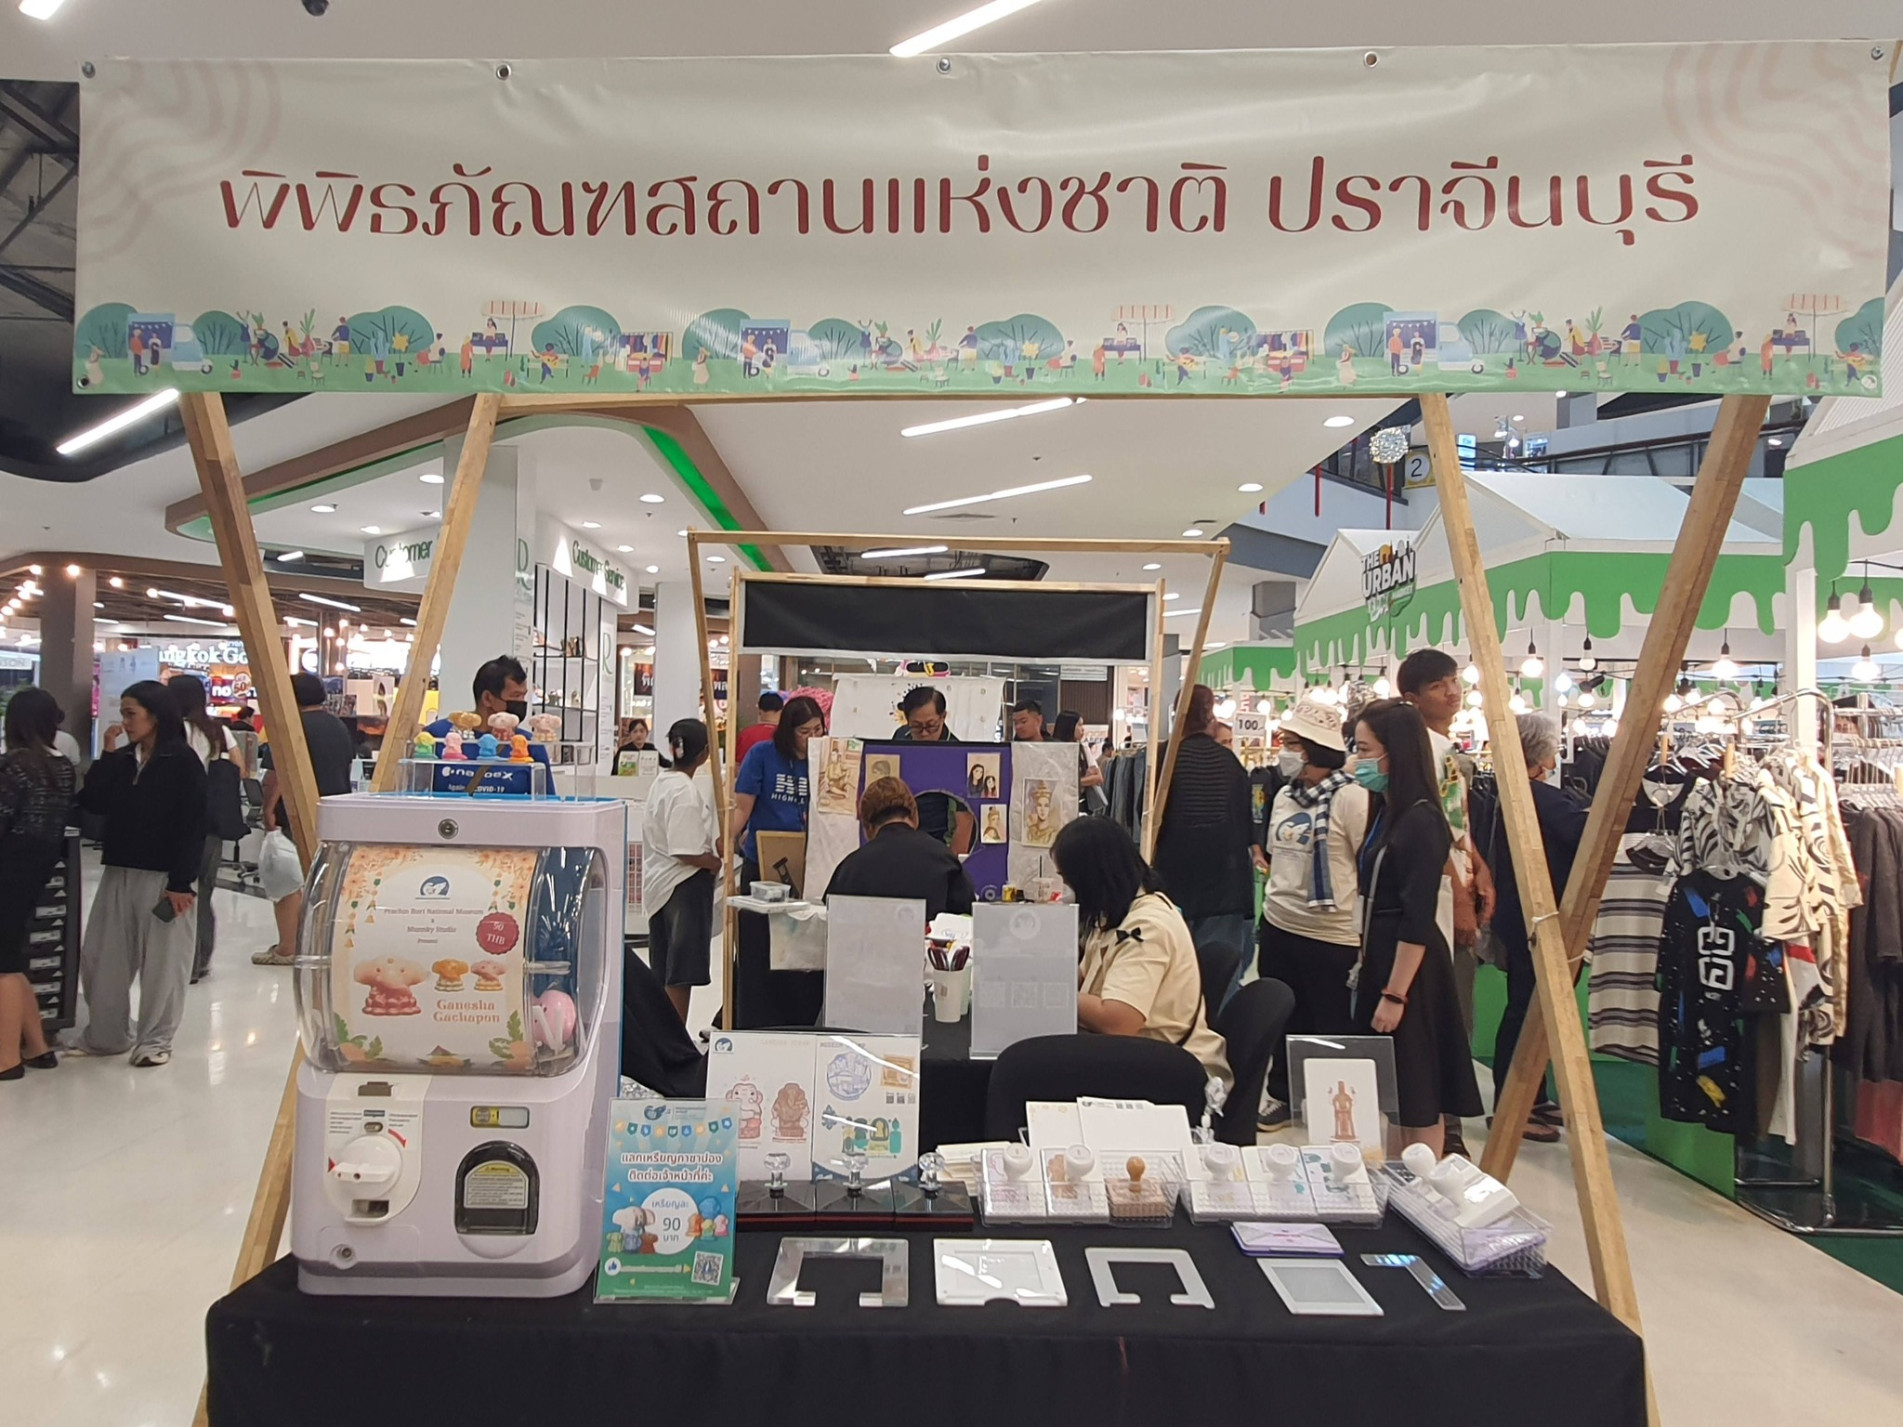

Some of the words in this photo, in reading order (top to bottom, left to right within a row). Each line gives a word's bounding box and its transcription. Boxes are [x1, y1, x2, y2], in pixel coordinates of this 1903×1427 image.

[220, 155, 1228, 238] พิพิธภัณฑสถานแห่งชาติ
[1270, 154, 1700, 246] ปราจีนบุรี
[1411, 457, 1423, 478] 2
[1361, 550, 1380, 573] THE
[1362, 551, 1416, 600] URBAN
[436, 999, 496, 1010] Ganesha
[662, 1217, 681, 1232] 90
